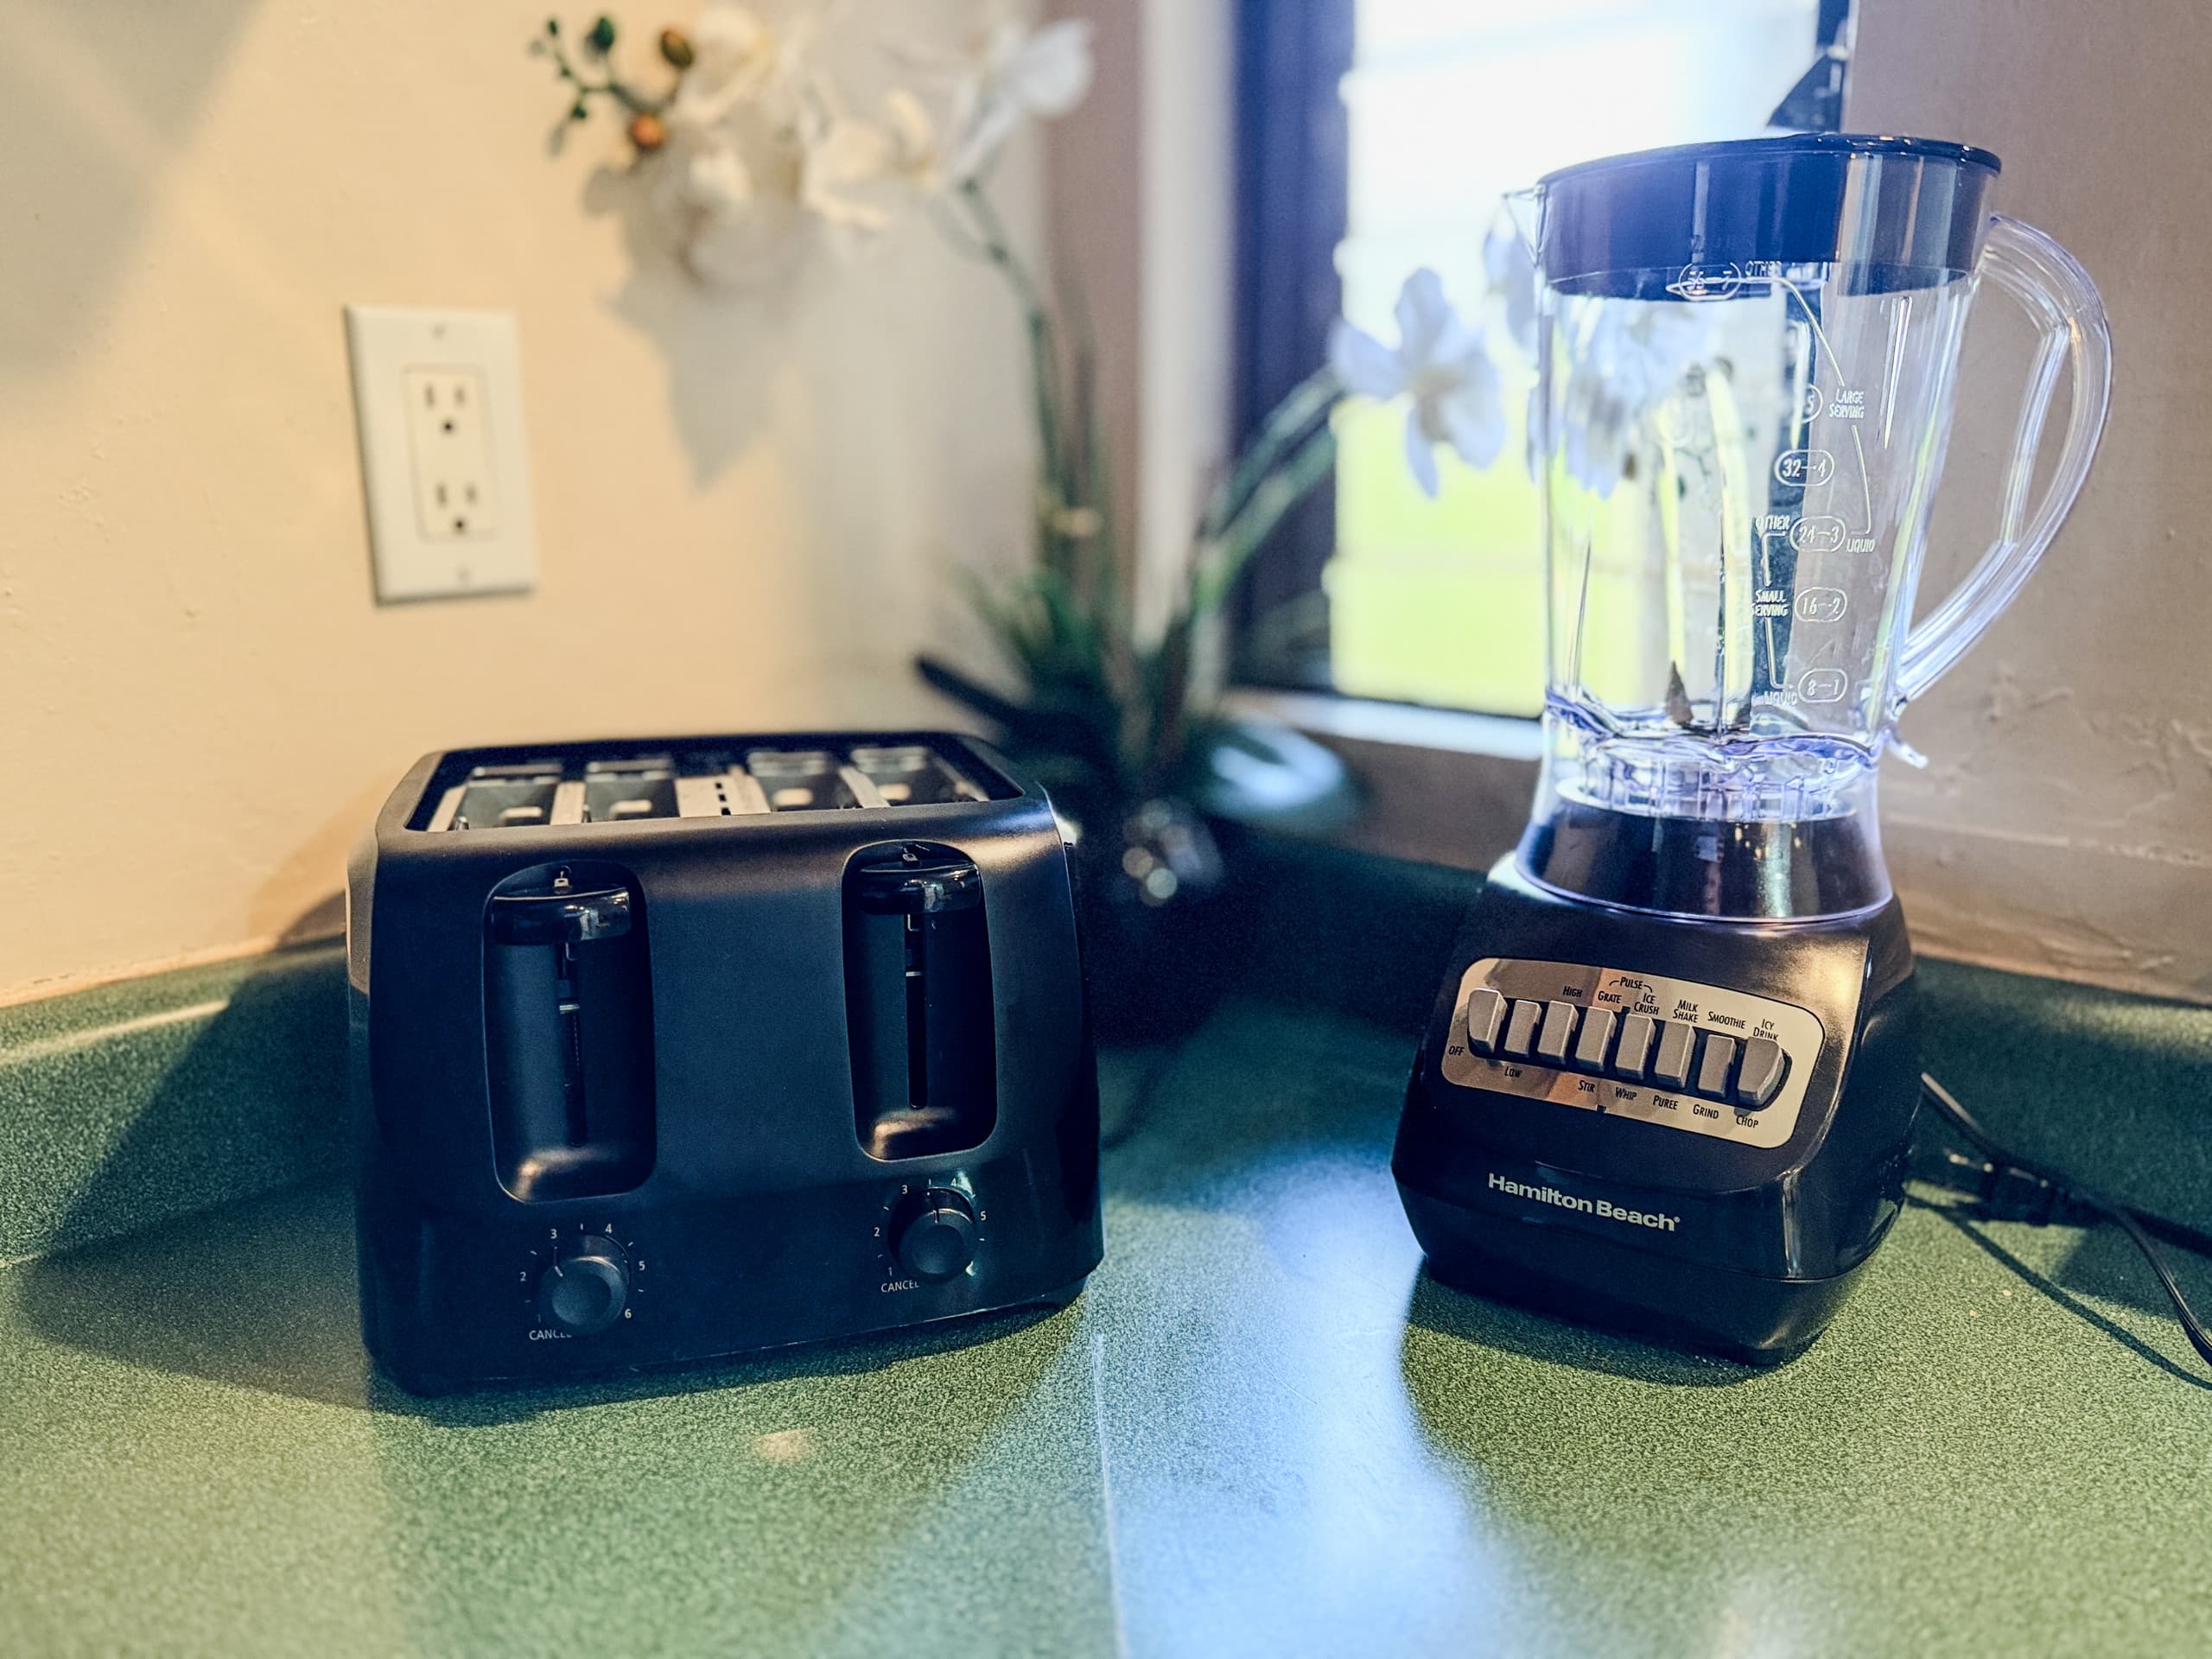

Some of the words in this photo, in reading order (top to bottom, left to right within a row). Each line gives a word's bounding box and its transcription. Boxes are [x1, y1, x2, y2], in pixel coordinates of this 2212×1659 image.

[1835, 388, 1864, 404] LARGE
[1828, 401, 1865, 419] SERVING
[1846, 538, 1875, 553] LIQUID
[1755, 588, 1787, 603] SMALL
[1749, 604, 1789, 617] SERVING
[1619, 976, 1643, 990] PULSE
[1562, 986, 1583, 998] HIGH
[1598, 990, 1622, 1004] GRATE
[1642, 993, 1656, 1005] ICE
[1633, 1002, 1659, 1015] CRUSH
[1677, 1000, 1699, 1013] MILK
[1673, 1008, 1698, 1023] SHAKE
[1707, 1011, 1746, 1030] SMOOTHIE
[1761, 1018, 1775, 1031] ICY
[1752, 1027, 1779, 1041] DRINK
[1448, 1046, 1465, 1056] OFF
[1504, 1065, 1522, 1078] LOW
[1578, 1080, 1595, 1093] STIR
[1615, 1086, 1637, 1101] WHIP
[1652, 1095, 1679, 1110] PUREE
[1693, 1103, 1719, 1120] GRIND
[1736, 1115, 1759, 1128] CHOP
[950, 1178, 957, 1187] 4
[901, 1185, 908, 1195] 3
[1488, 1173, 1593, 1214] Hamilton
[980, 1211, 987, 1221] 5
[550, 1229, 557, 1239] 3
[605, 1223, 613, 1234] 4
[874, 1226, 880, 1237] 2
[639, 1261, 646, 1271] 5
[519, 1271, 527, 1282] 2
[624, 1308, 632, 1319] 6
